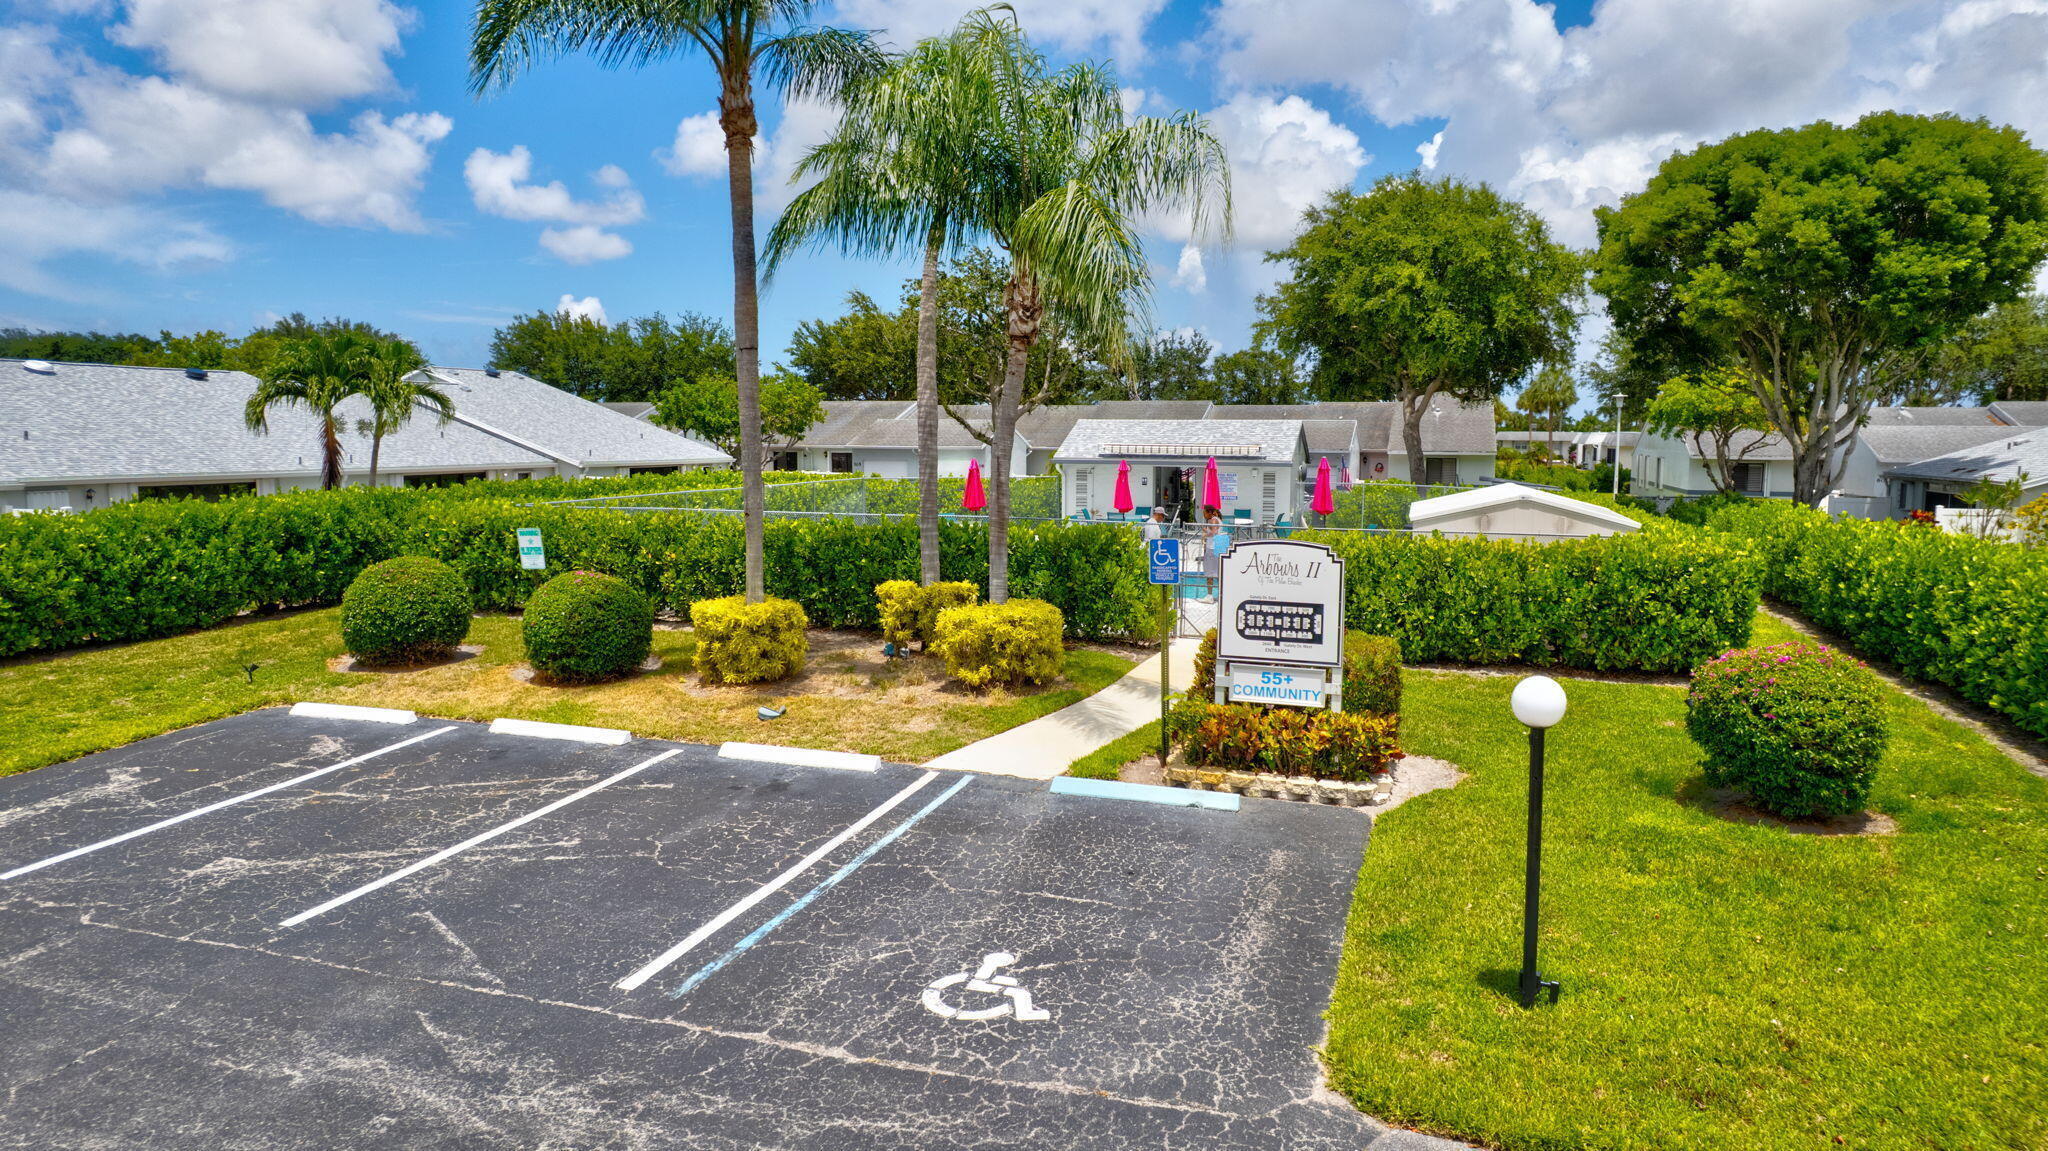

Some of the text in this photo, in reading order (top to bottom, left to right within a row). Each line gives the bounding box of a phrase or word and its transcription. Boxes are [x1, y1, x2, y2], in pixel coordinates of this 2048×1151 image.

[1240, 551, 1322, 578] Arbours II
[1261, 671, 1294, 685] 55+
[1233, 684, 1321, 701] COMMUNITY
